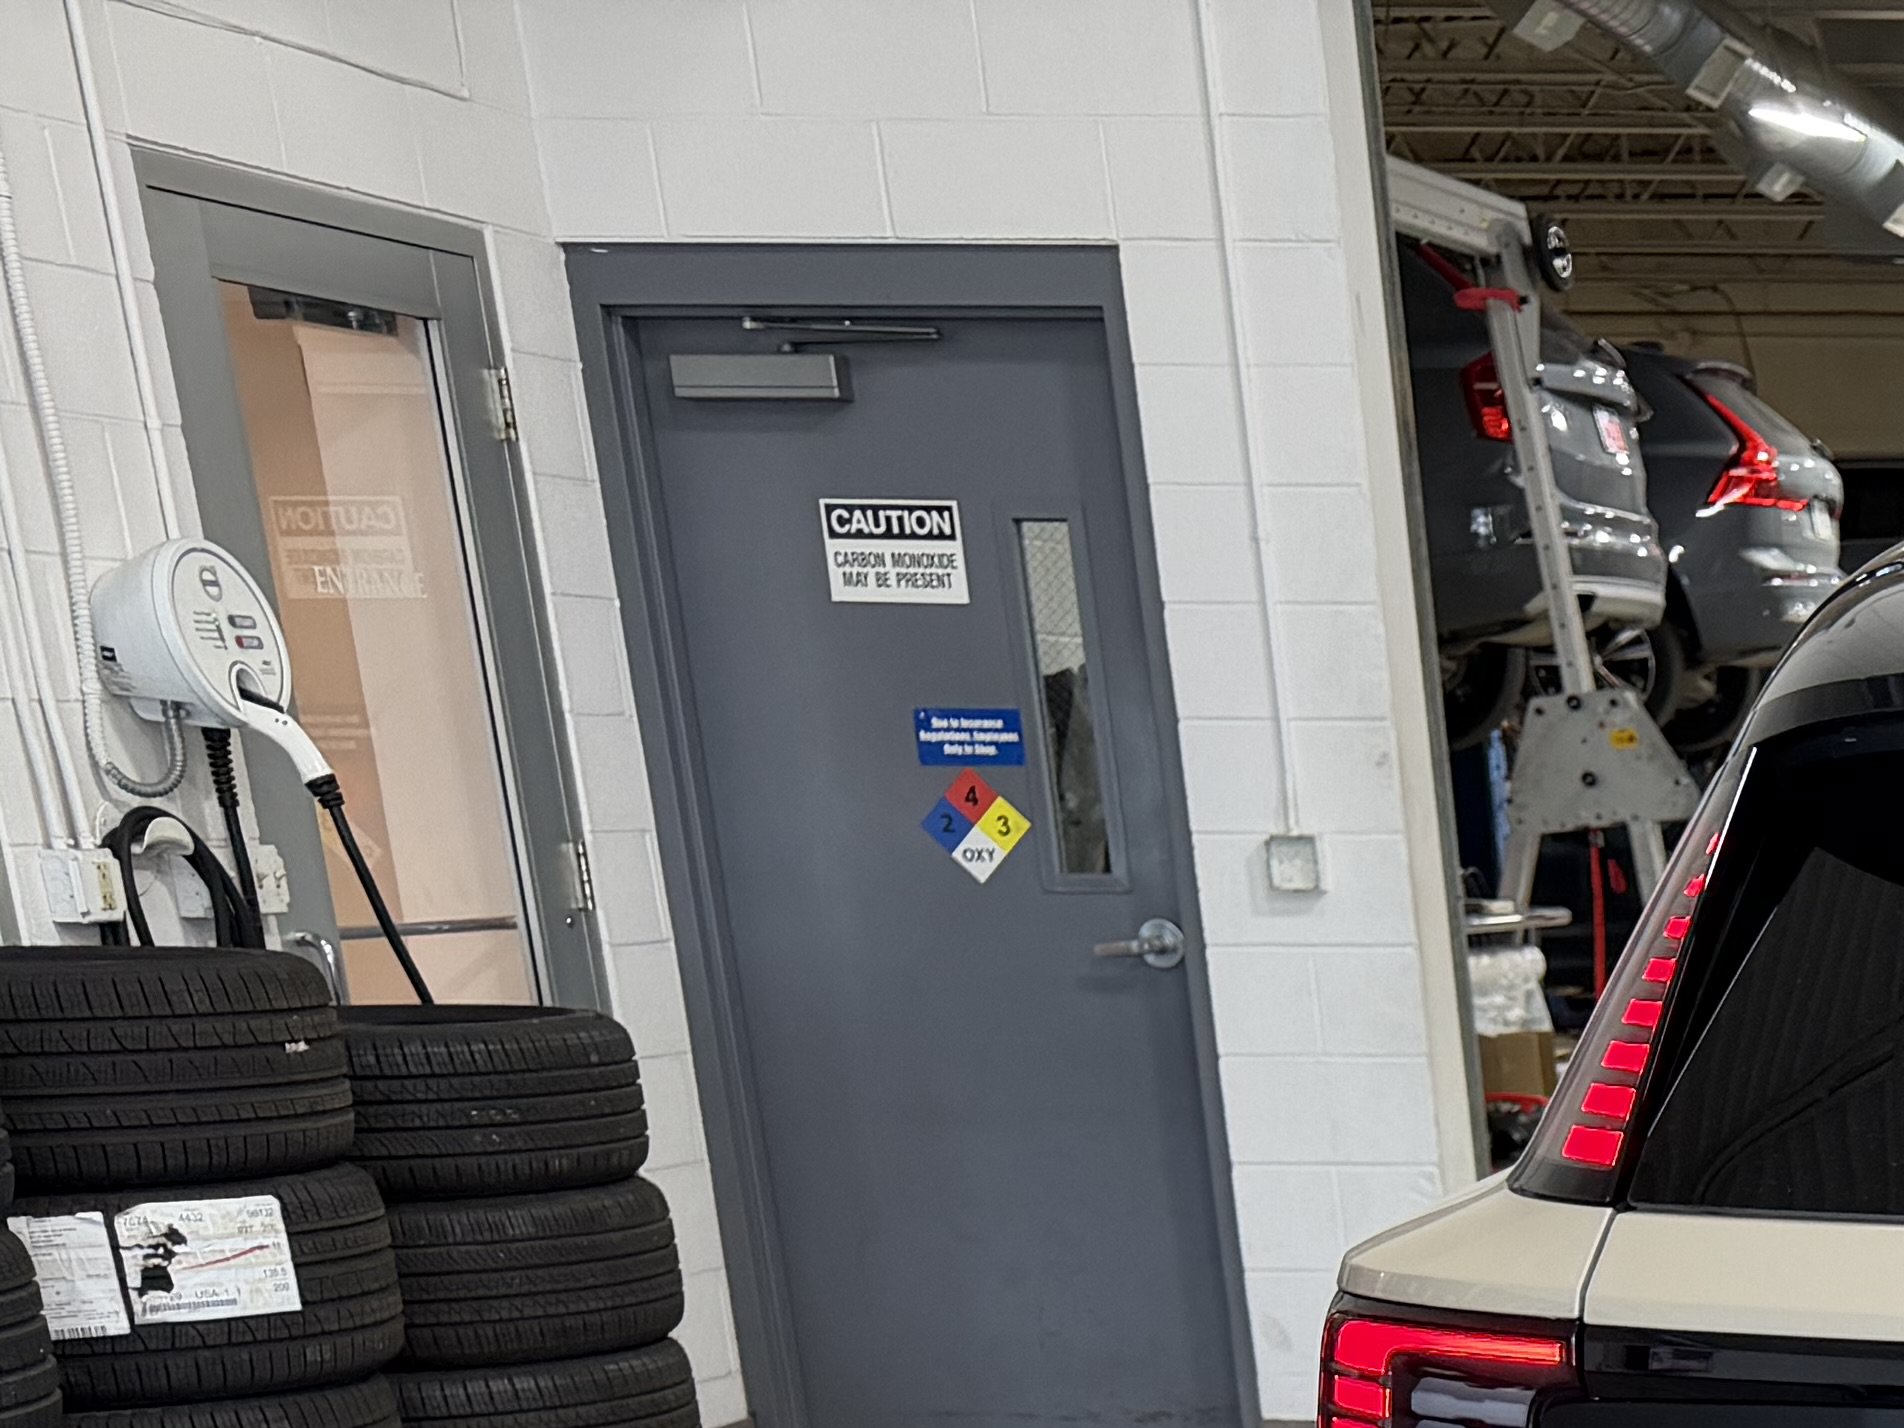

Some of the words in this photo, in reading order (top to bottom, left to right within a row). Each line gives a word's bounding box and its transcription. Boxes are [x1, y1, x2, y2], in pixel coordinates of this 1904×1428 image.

[830, 508, 952, 536] CAUTION
[834, 551, 886, 569] CARBON
[890, 551, 958, 570] MONOXIDE
[842, 571, 869, 588] MAY
[874, 571, 891, 588] BE
[895, 571, 952, 589] PRESENT
[964, 785, 979, 807] 4
[940, 813, 956, 833] 2
[996, 815, 1012, 837] 3
[962, 847, 996, 863] OXY
